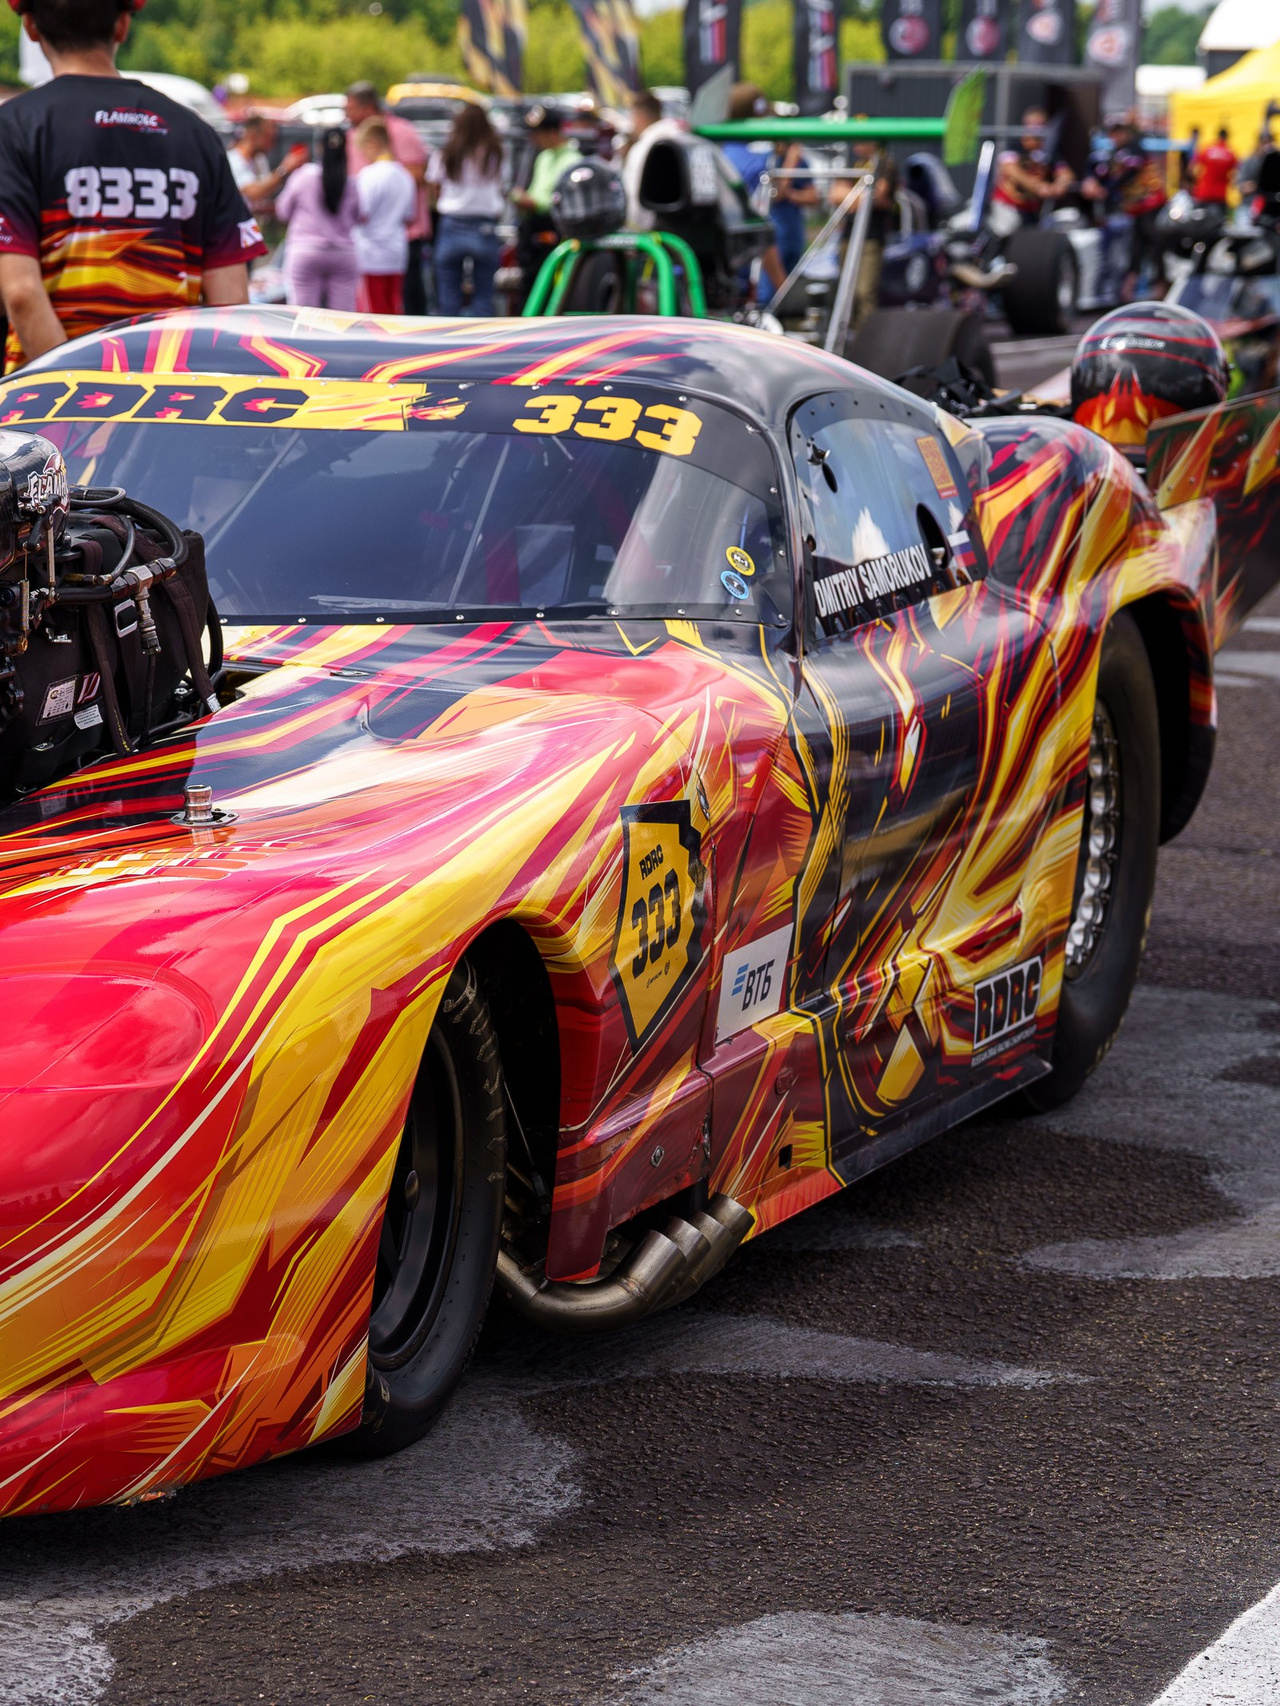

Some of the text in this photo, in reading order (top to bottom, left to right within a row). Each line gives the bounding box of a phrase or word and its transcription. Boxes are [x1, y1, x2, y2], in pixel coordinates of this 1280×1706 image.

[64, 166, 199, 220] 8333
[512, 395, 703, 456] 333
[813, 543, 932, 618] DMITRIY SAMORUKOV
[631, 868, 681, 979] 333
[742, 959, 775, 1011] ВТБ
